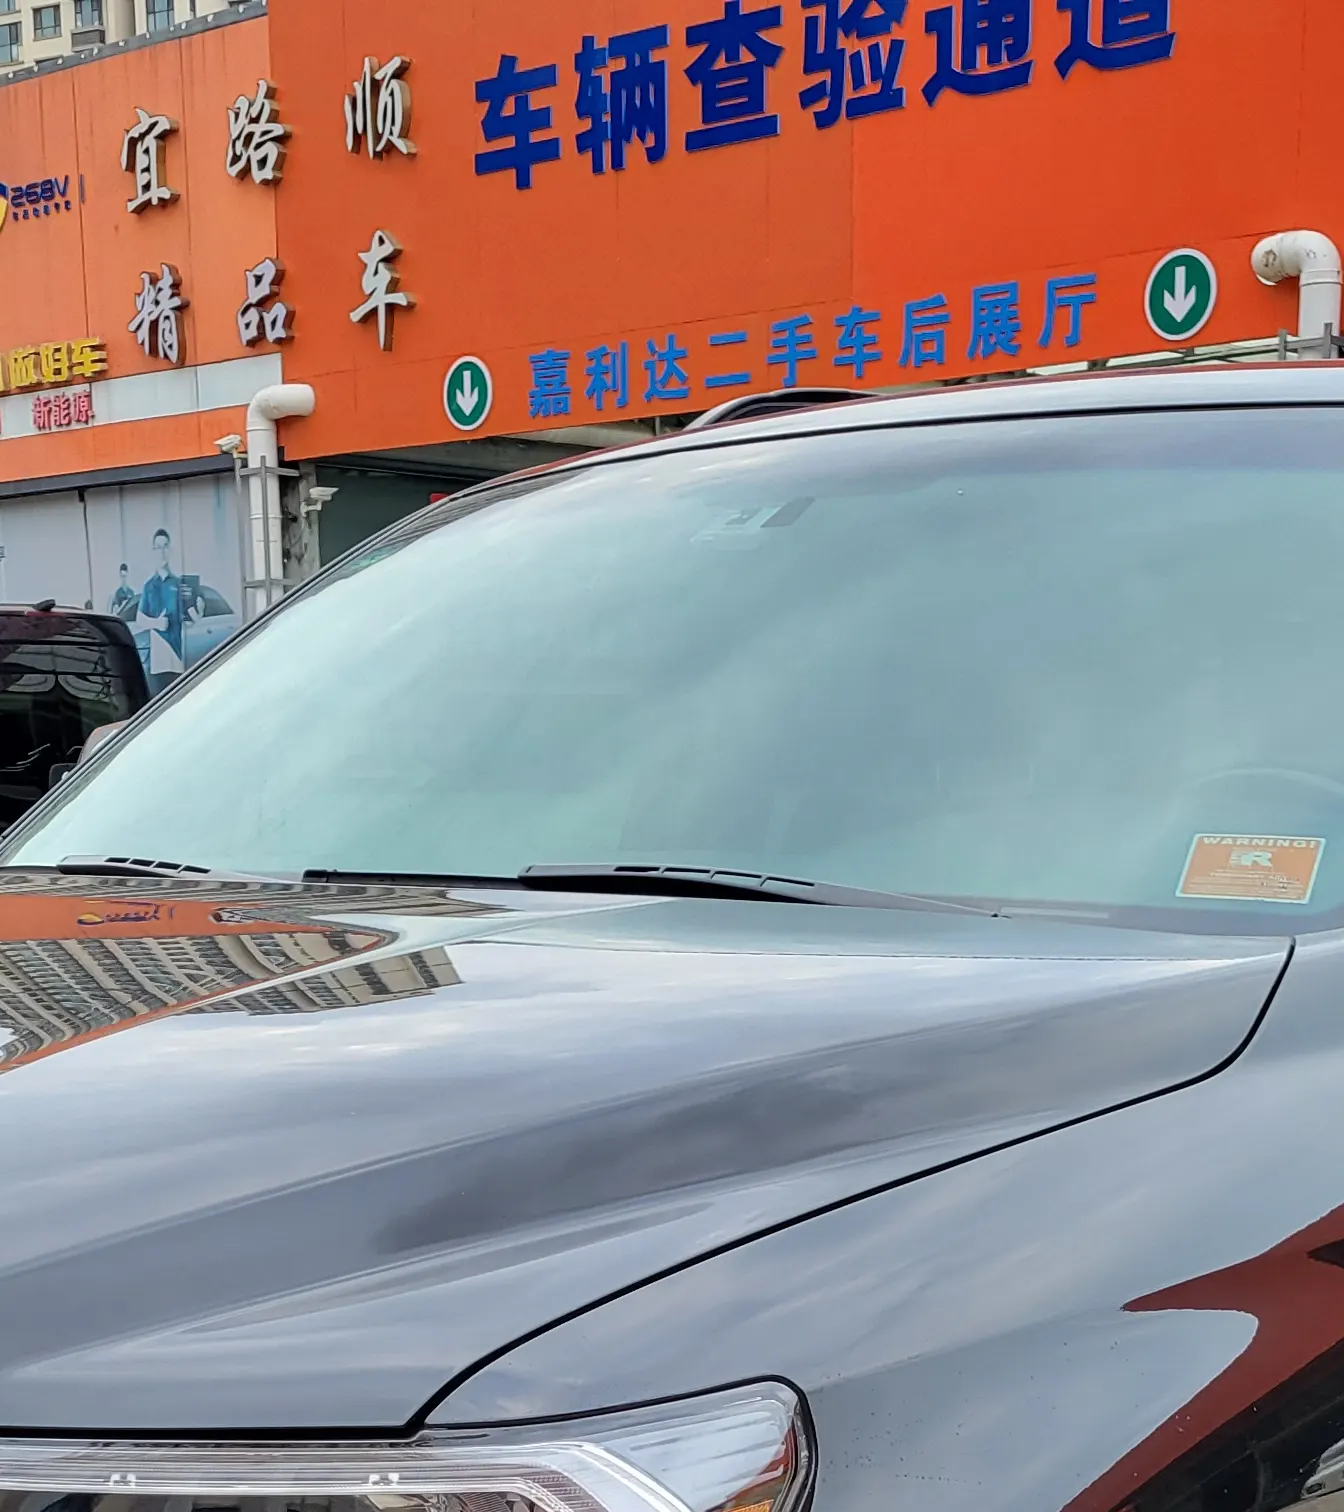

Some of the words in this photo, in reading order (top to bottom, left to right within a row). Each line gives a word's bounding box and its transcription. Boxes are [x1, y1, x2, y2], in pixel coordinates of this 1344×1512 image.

[120, 55, 417, 214] 宜路顺
[10, 175, 69, 208] 268V
[128, 228, 416, 366] 精品车
[527, 273, 1099, 418] 嘉利达二手车后展厅
[32, 389, 96, 431] 新能源
[1203, 836, 1317, 849] WARNING!
